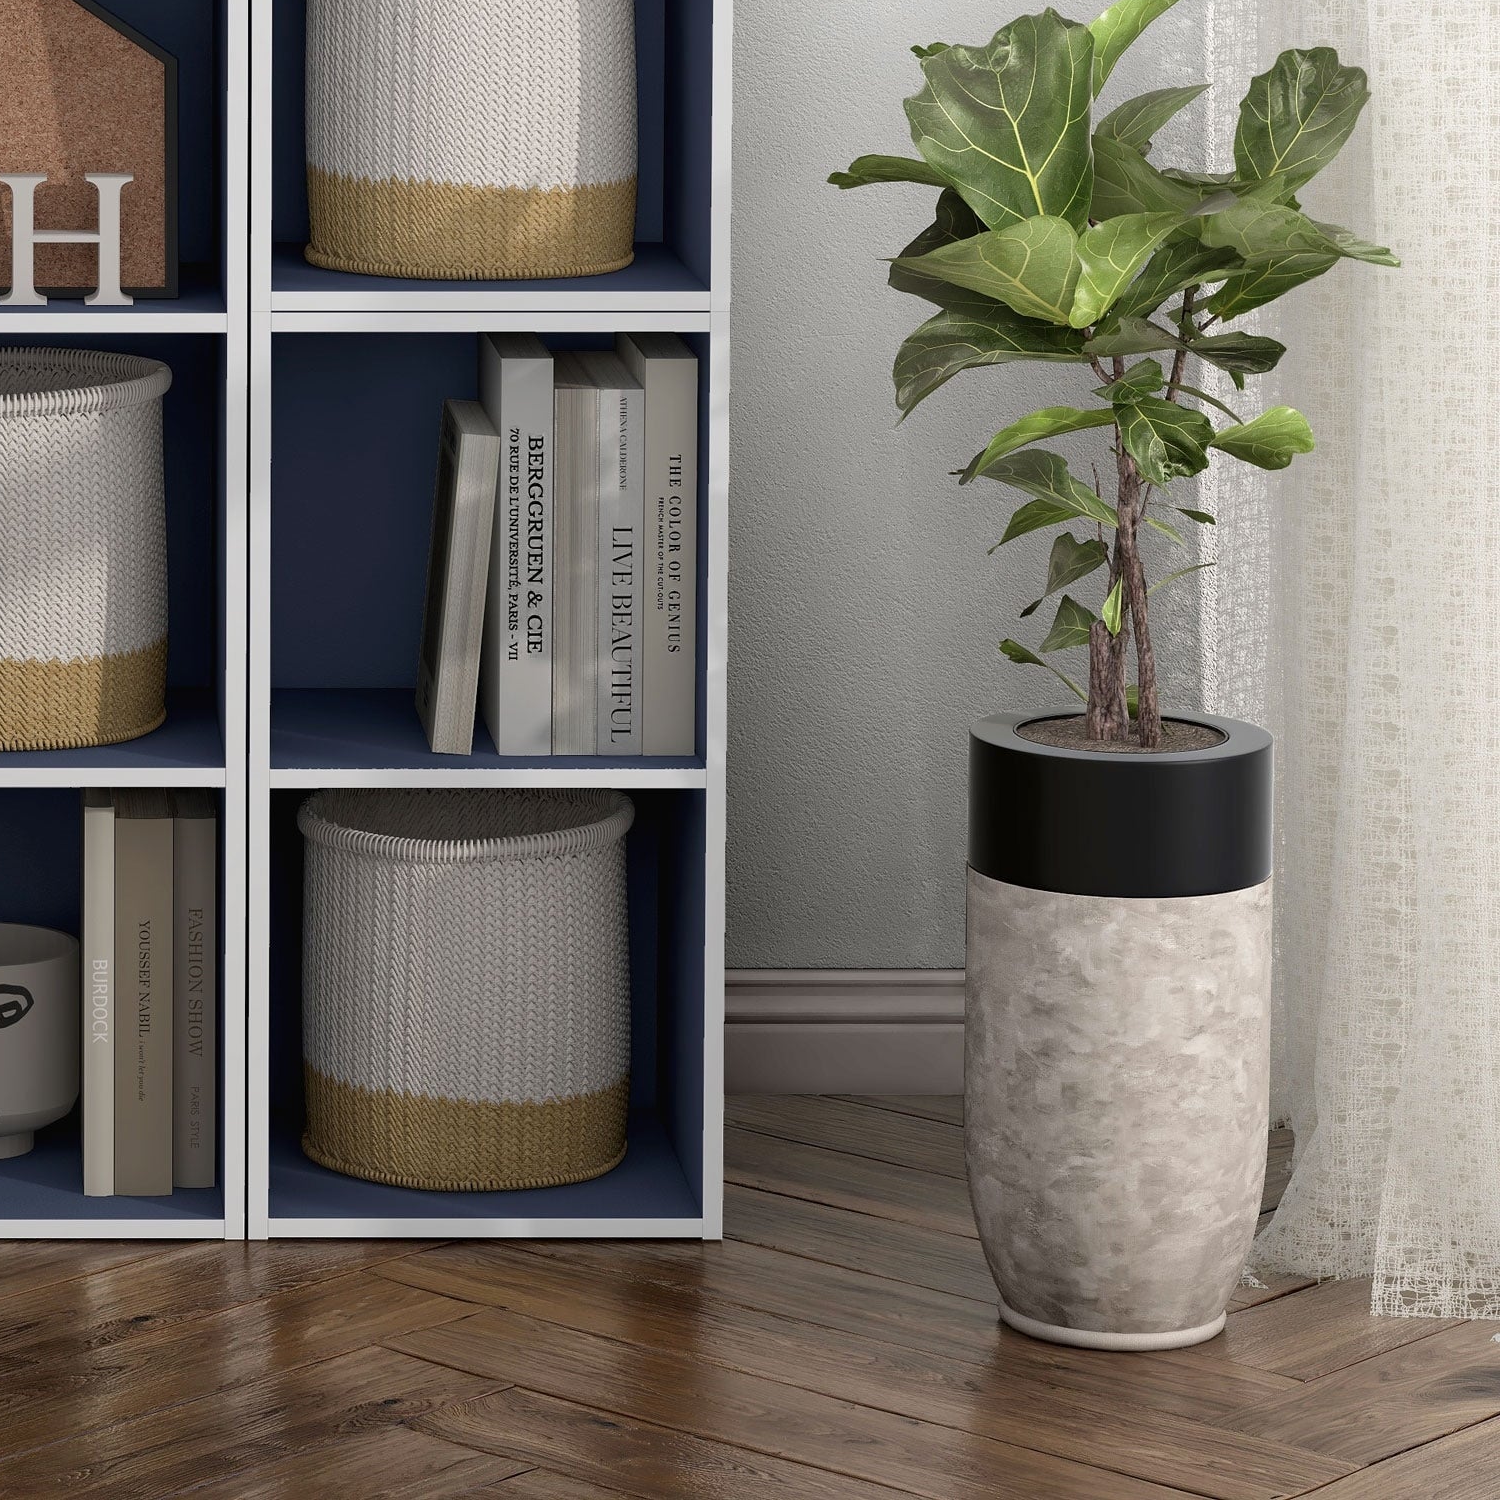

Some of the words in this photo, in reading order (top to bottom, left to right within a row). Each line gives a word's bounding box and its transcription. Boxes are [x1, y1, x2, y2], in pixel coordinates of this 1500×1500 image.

[620, 396, 628, 433] ATHENA
[509, 428, 520, 443] 70
[509, 445, 519, 473] RUE
[619, 434, 628, 491] CALDERONE
[669, 454, 682, 487] THE
[509, 475, 519, 494] DE
[527, 436, 545, 585] BERGGRUEN
[669, 495, 682, 553] COLOR
[507, 496, 521, 591] L'UNIVERSITÉ,
[611, 526, 633, 586] LIVE
[658, 551, 664, 560] OF
[669, 561, 681, 582] OF
[509, 594, 519, 631] PARIS
[527, 590, 543, 609] &
[527, 614, 543, 654] CIE
[668, 591, 681, 653] GENIUS
[508, 642, 519, 661] VII
[610, 594, 633, 744] BEAUTIFUL
[139, 920, 151, 988] YOUSSEF
[188, 908, 204, 993] FASHION
[92, 959, 108, 1043] BURDOCK
[139, 992, 151, 1038] NABIL
[188, 999, 204, 1057] SHOW
[190, 1086, 200, 1116] PARIS
[189, 1120, 200, 1149] STYLE
